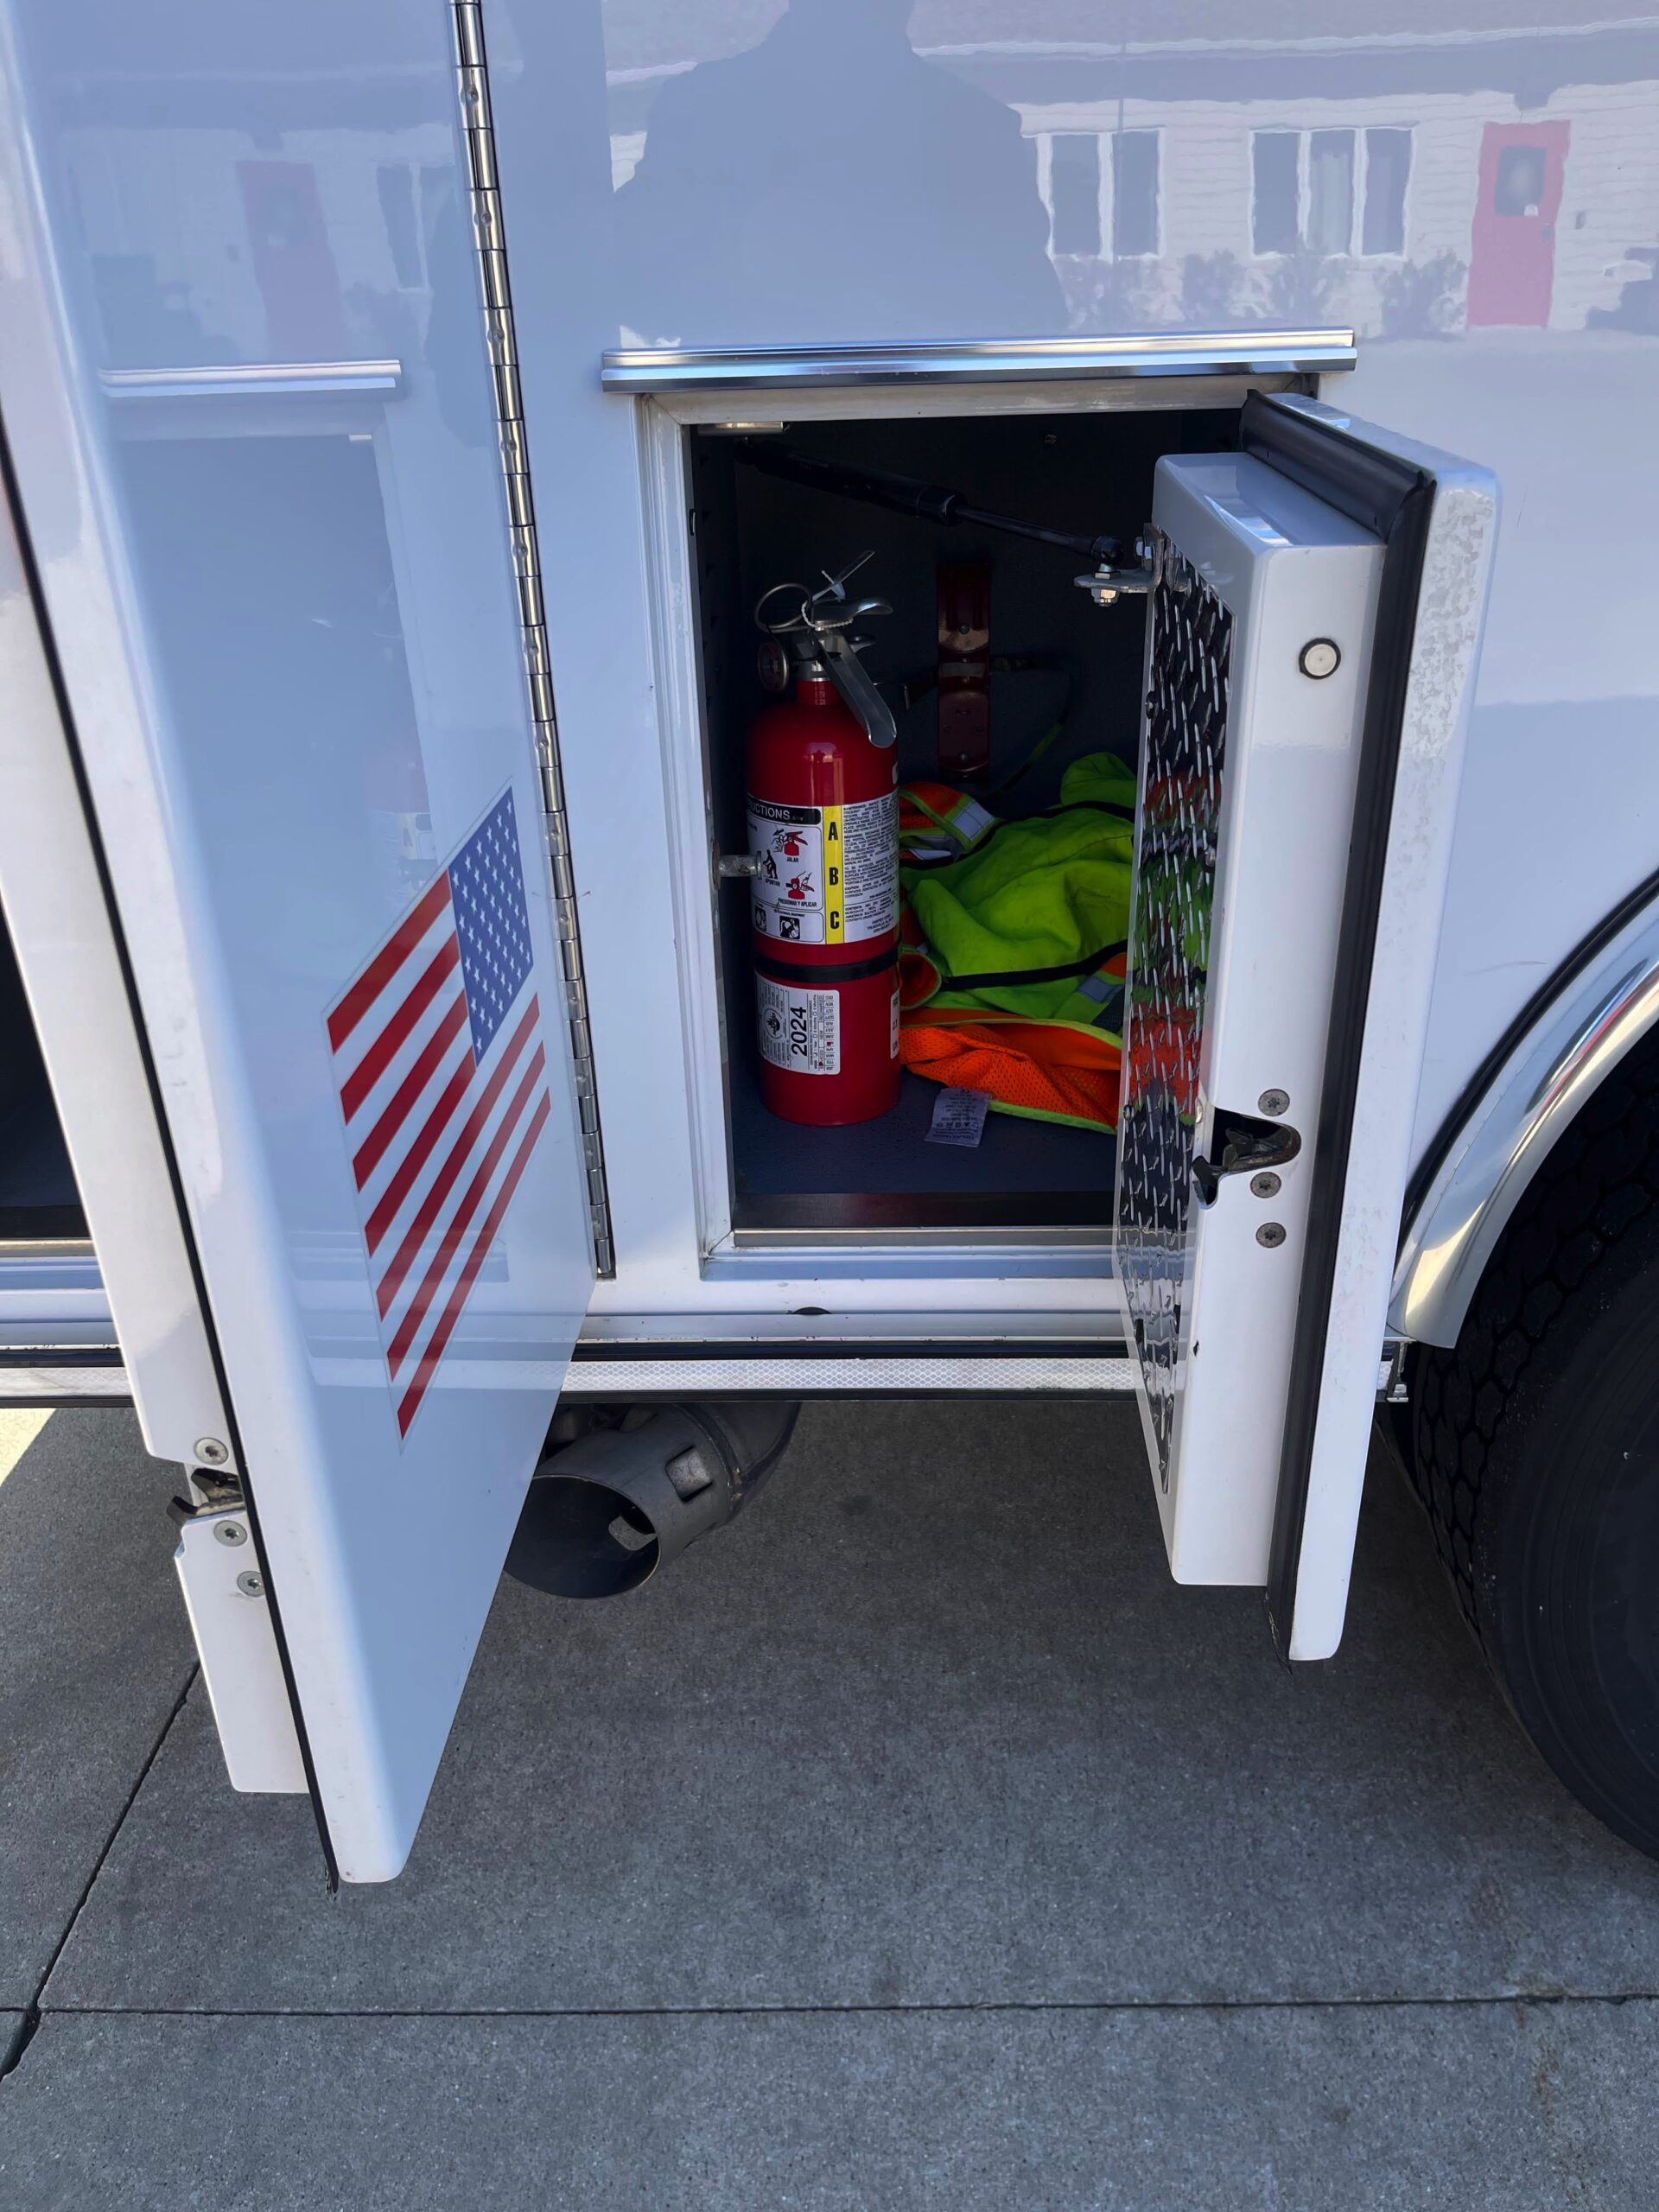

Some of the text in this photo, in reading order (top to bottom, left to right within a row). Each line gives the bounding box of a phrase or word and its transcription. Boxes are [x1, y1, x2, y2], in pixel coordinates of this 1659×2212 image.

[828, 822, 838, 842] A
[829, 867, 839, 886] B
[830, 911, 840, 930] C
[790, 1006, 808, 1057] 2024
